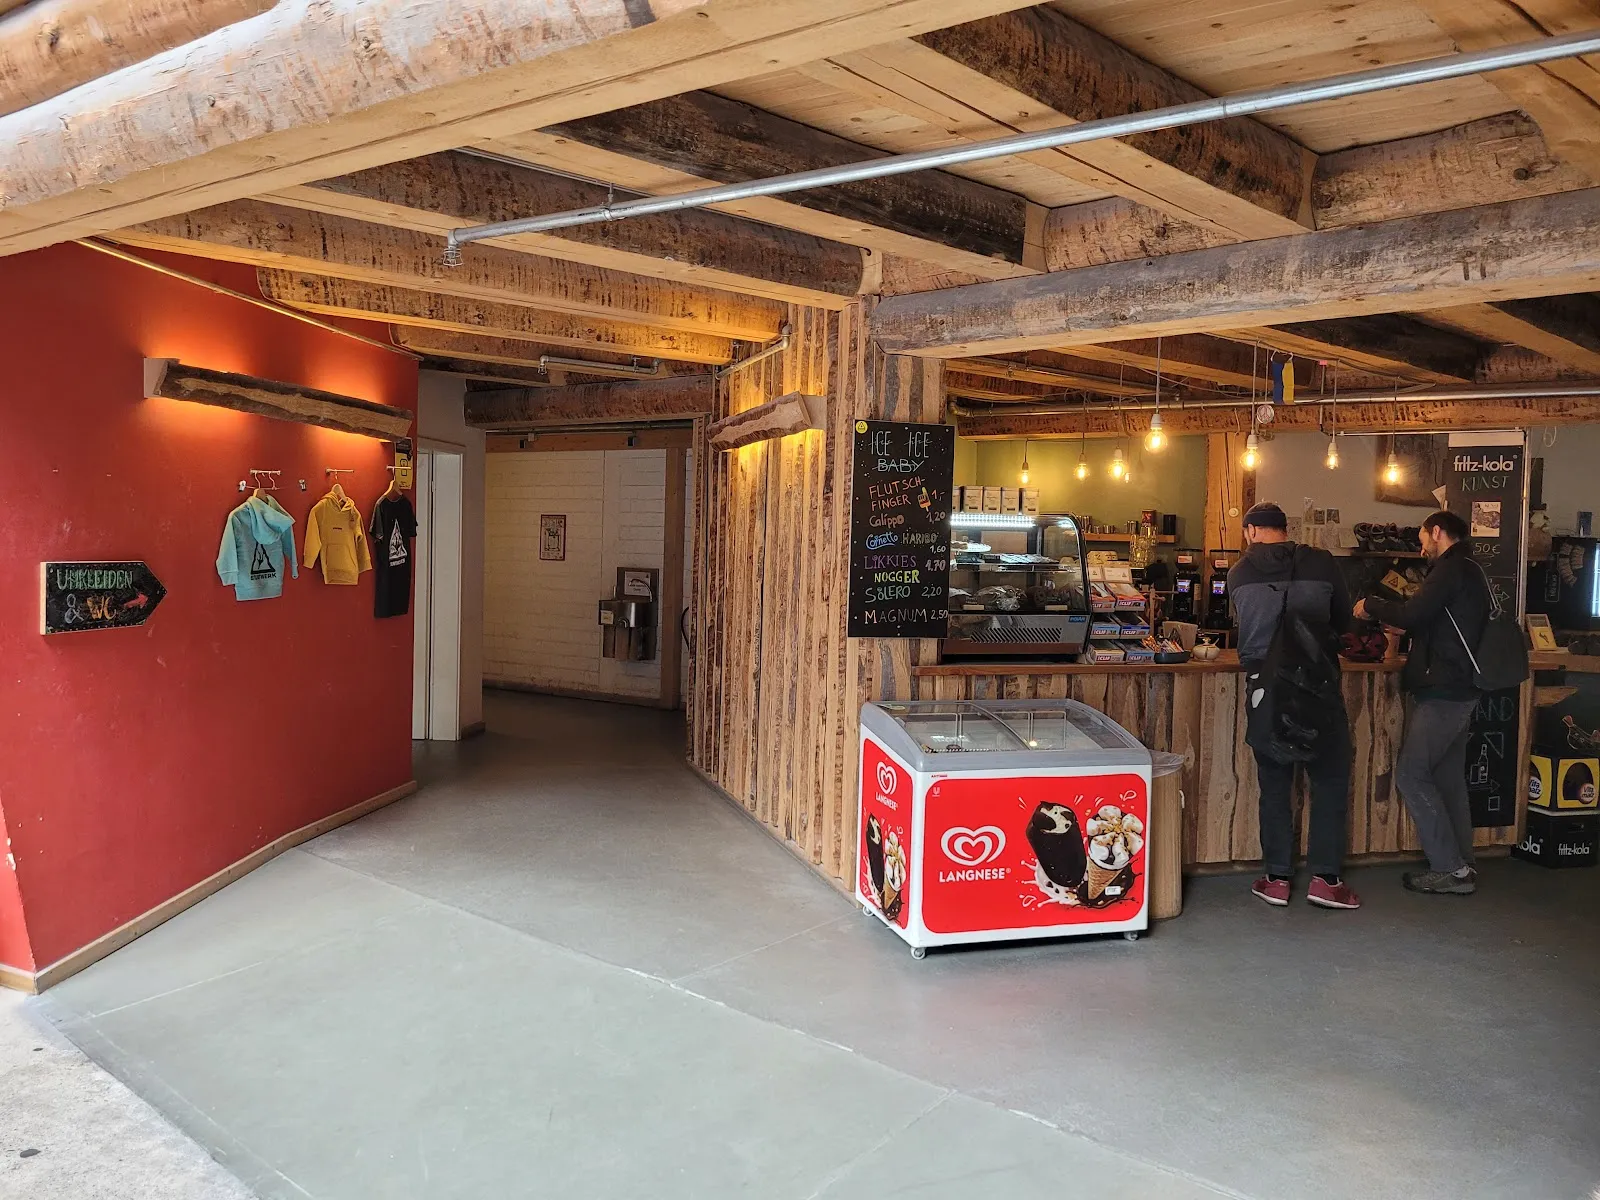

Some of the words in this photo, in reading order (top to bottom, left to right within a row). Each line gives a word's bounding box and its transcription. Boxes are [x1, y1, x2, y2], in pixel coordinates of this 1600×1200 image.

[871, 430, 891, 456] ICE
[908, 431, 930, 458] ICE
[877, 458, 924, 473] BABY
[1462, 476, 1510, 492] KUNST
[871, 494, 912, 512] FINGER
[869, 513, 904, 529] Calippo
[926, 512, 946, 524] 1,20
[866, 531, 898, 550] Cornetto
[902, 532, 938, 544] HARIBO
[930, 545, 946, 554] 1,60
[56, 569, 133, 590] UMKLEIDEN
[874, 570, 920, 584] NOGGER
[922, 586, 942, 598] 2,20
[64, 594, 84, 624] &
[86, 595, 117, 620] WC
[864, 608, 928, 624] MAGNUM
[930, 610, 948, 620] 2,50
[1474, 696, 1514, 721] AND
[876, 792, 897, 811] LANGNESE
